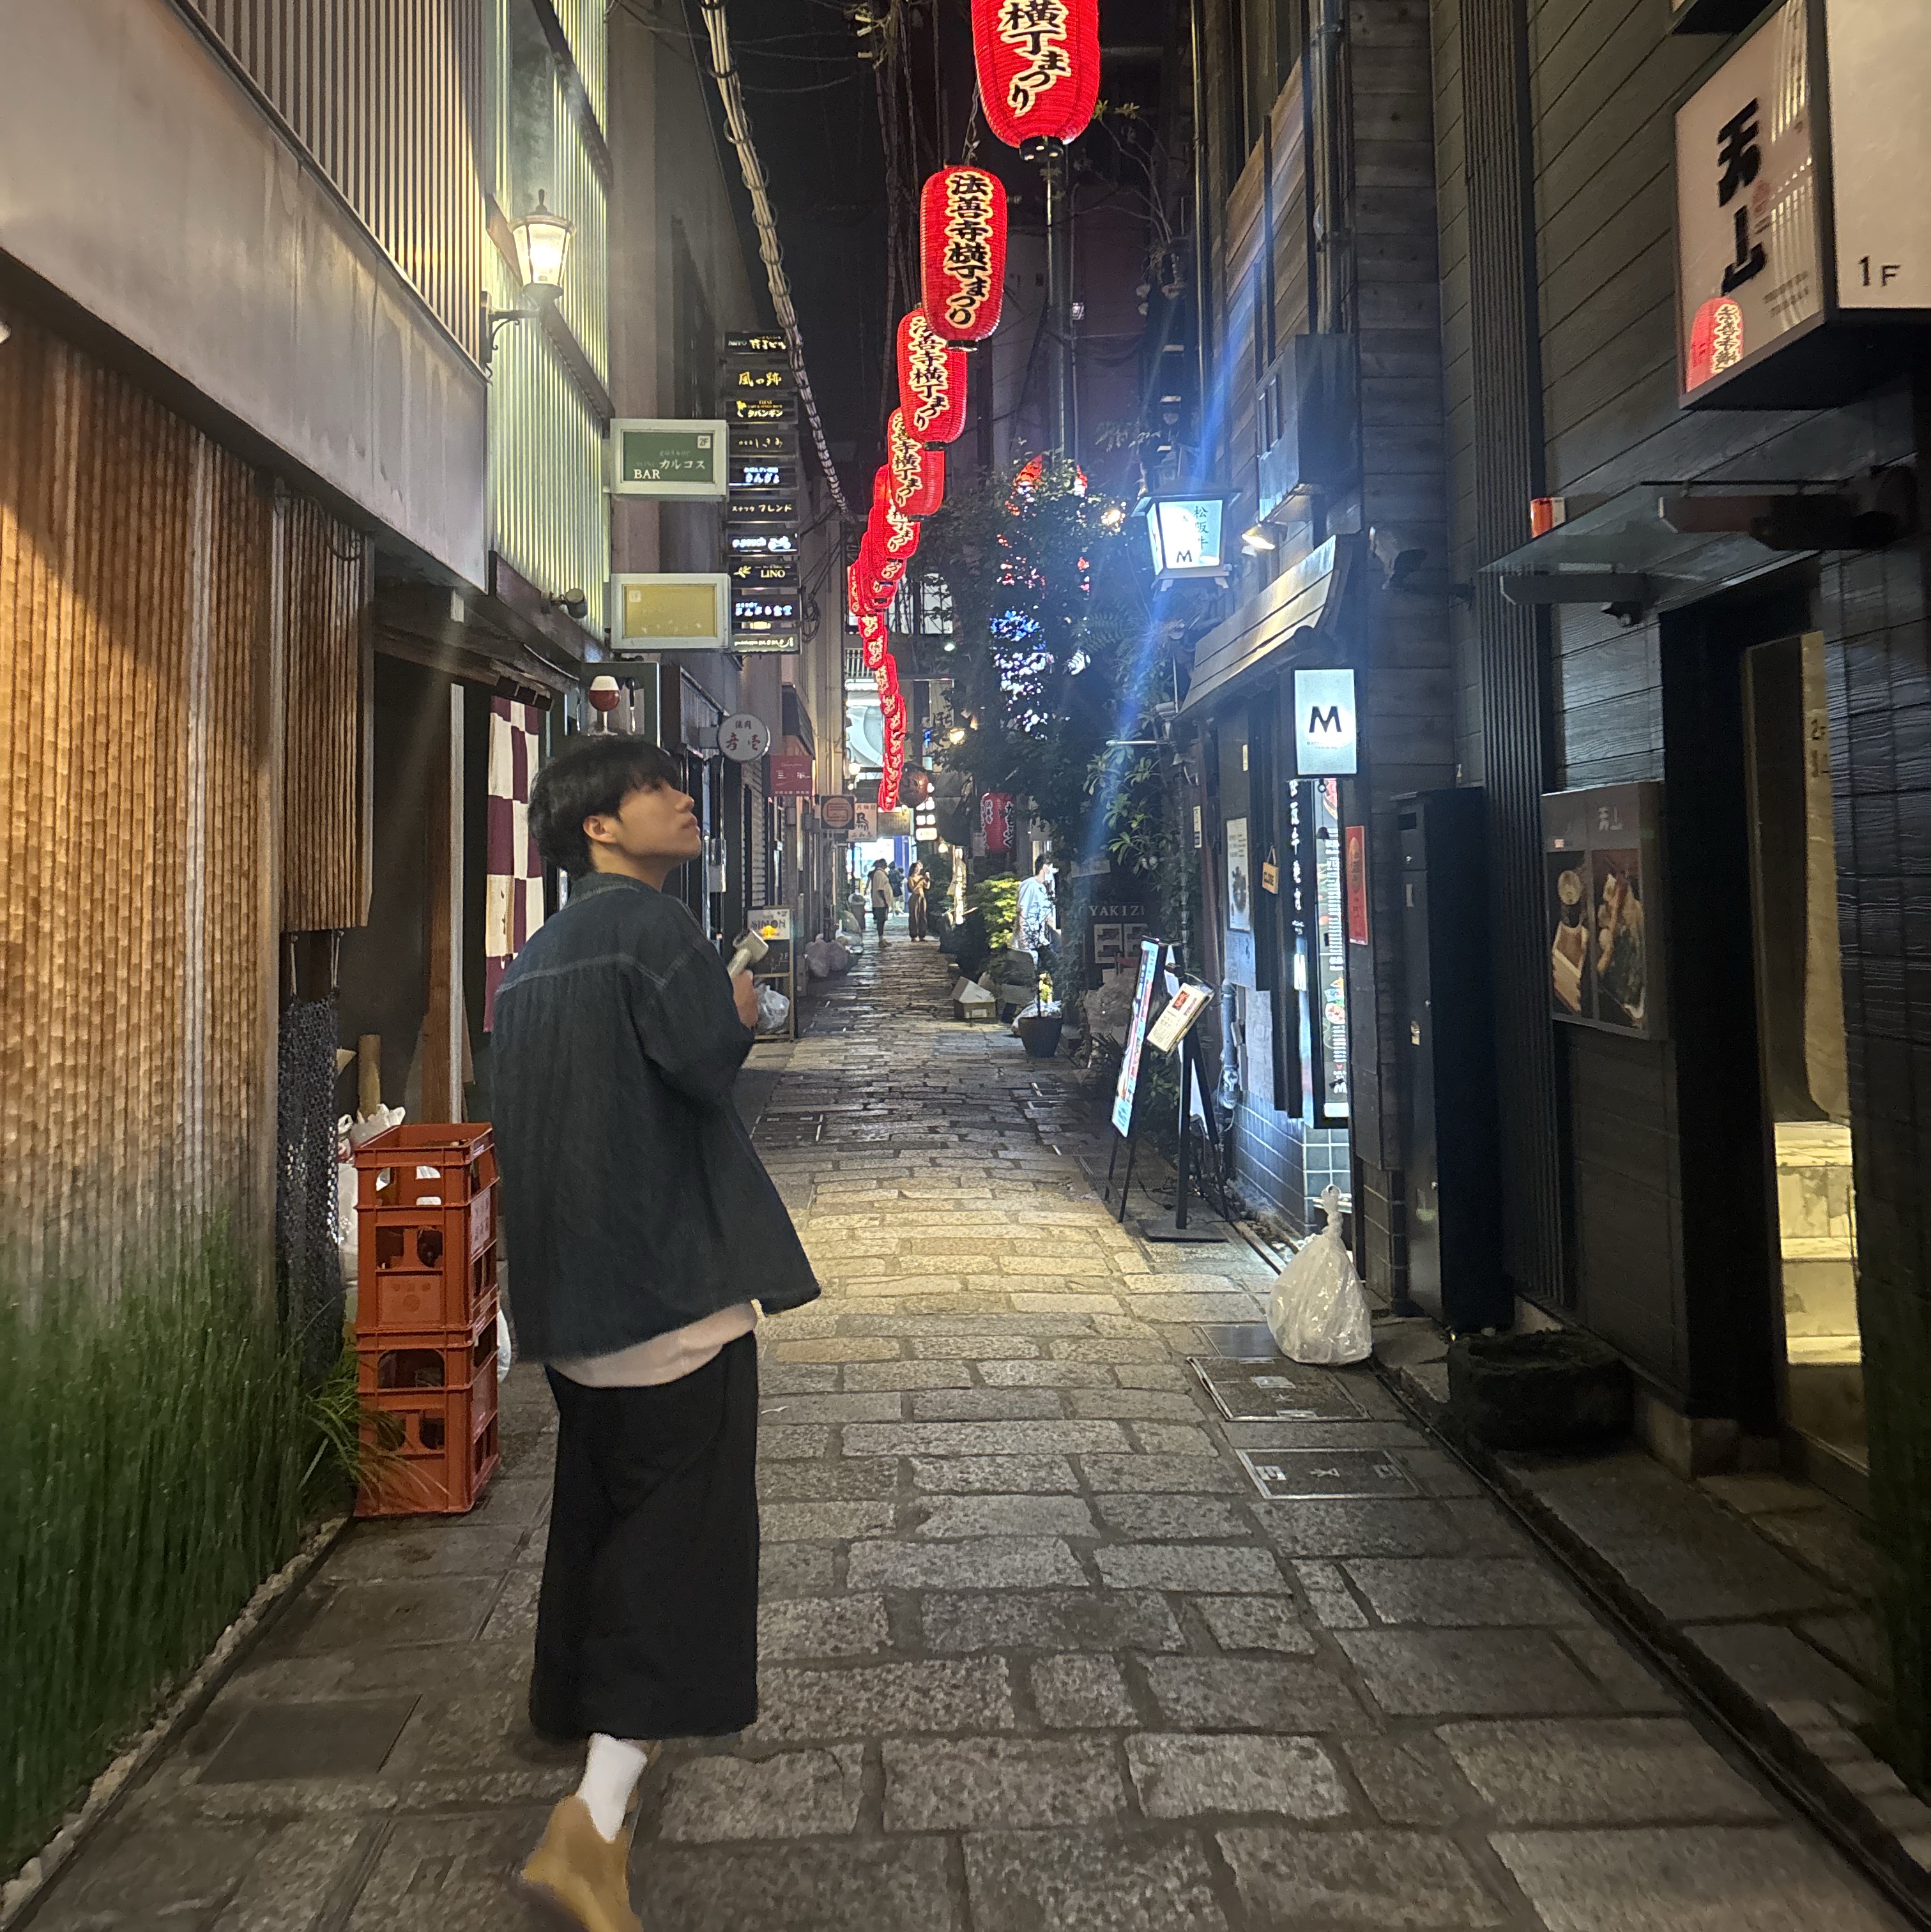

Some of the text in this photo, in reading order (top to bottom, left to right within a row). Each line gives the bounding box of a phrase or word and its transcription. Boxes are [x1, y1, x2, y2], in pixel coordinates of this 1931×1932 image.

[947, 172, 992, 327] 法善寺横丁まつり
[1859, 255, 1900, 287] 1F
[659, 459, 705, 469] カルコス
[634, 469, 660, 479] BAR
[758, 503, 792, 512] フレンド
[1177, 549, 1193, 563] M
[760, 570, 786, 578] LINO
[1309, 706, 1342, 733] M
